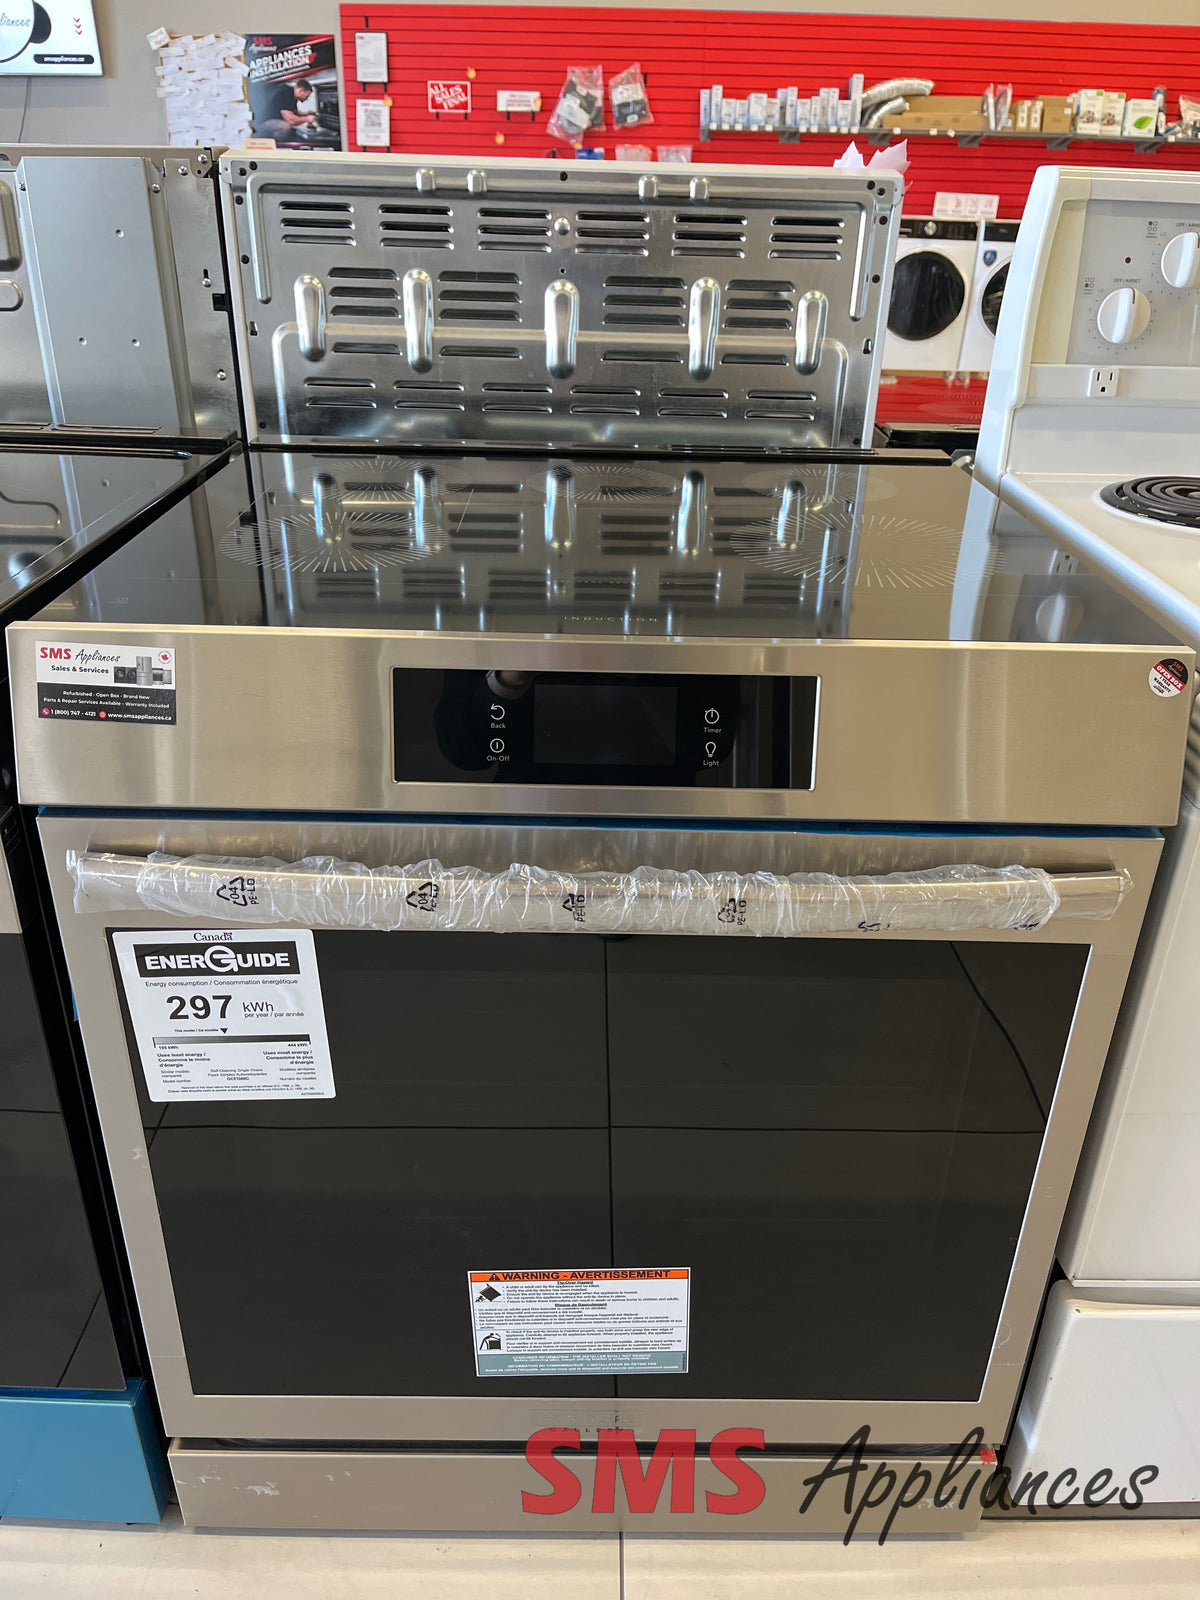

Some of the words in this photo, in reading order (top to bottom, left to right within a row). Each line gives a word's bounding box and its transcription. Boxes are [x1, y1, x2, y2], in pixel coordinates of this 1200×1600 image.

[250, 45, 312, 69] APPLIANCES
[430, 83, 446, 96] ALL
[435, 84, 462, 104] SALES
[443, 92, 467, 109] FINAL
[40, 647, 71, 660] SMS
[75, 649, 120, 664] Appliances
[1156, 666, 1171, 679] OPEN
[1170, 676, 1183, 689] BOX
[229, 887, 240, 899] 04
[247, 878, 259, 904] PE-LD
[193, 932, 233, 941] Canada
[144, 945, 290, 973] ENERGUIDE
[166, 994, 232, 1020] 297
[242, 1002, 274, 1012] kWh
[503, 1272, 559, 1280] WARNING
[570, 1270, 670, 1280] AVERTISSEMENT
